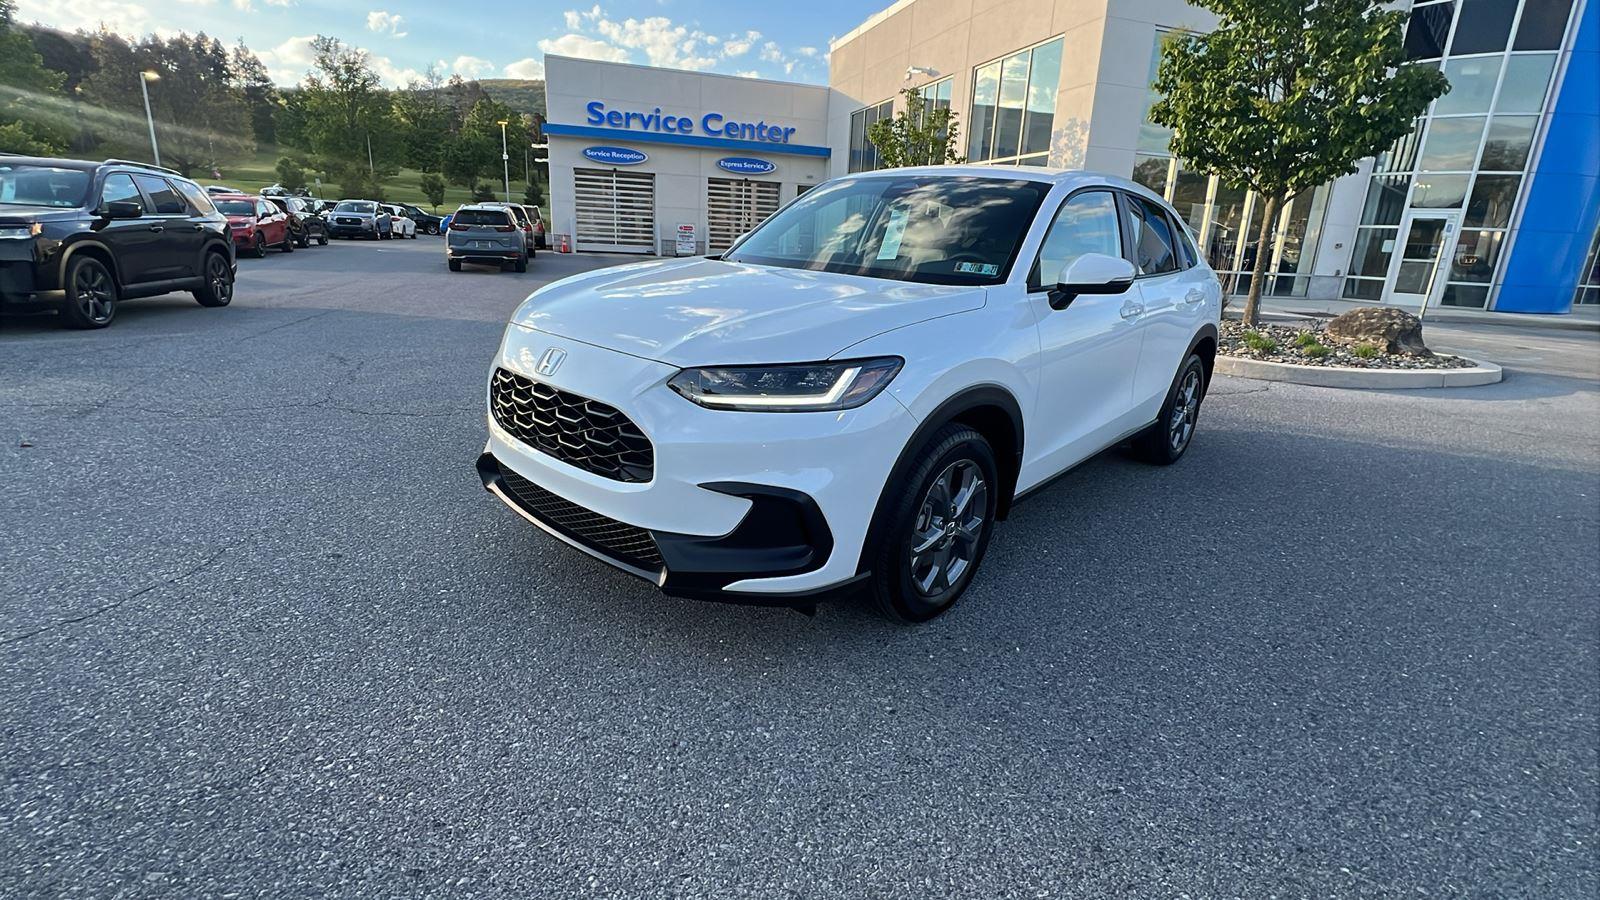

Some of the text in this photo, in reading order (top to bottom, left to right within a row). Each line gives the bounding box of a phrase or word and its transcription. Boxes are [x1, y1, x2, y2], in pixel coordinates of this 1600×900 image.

[586, 101, 796, 143] Service Center
[586, 149, 644, 160] Service Reception
[720, 160, 743, 168] Express
